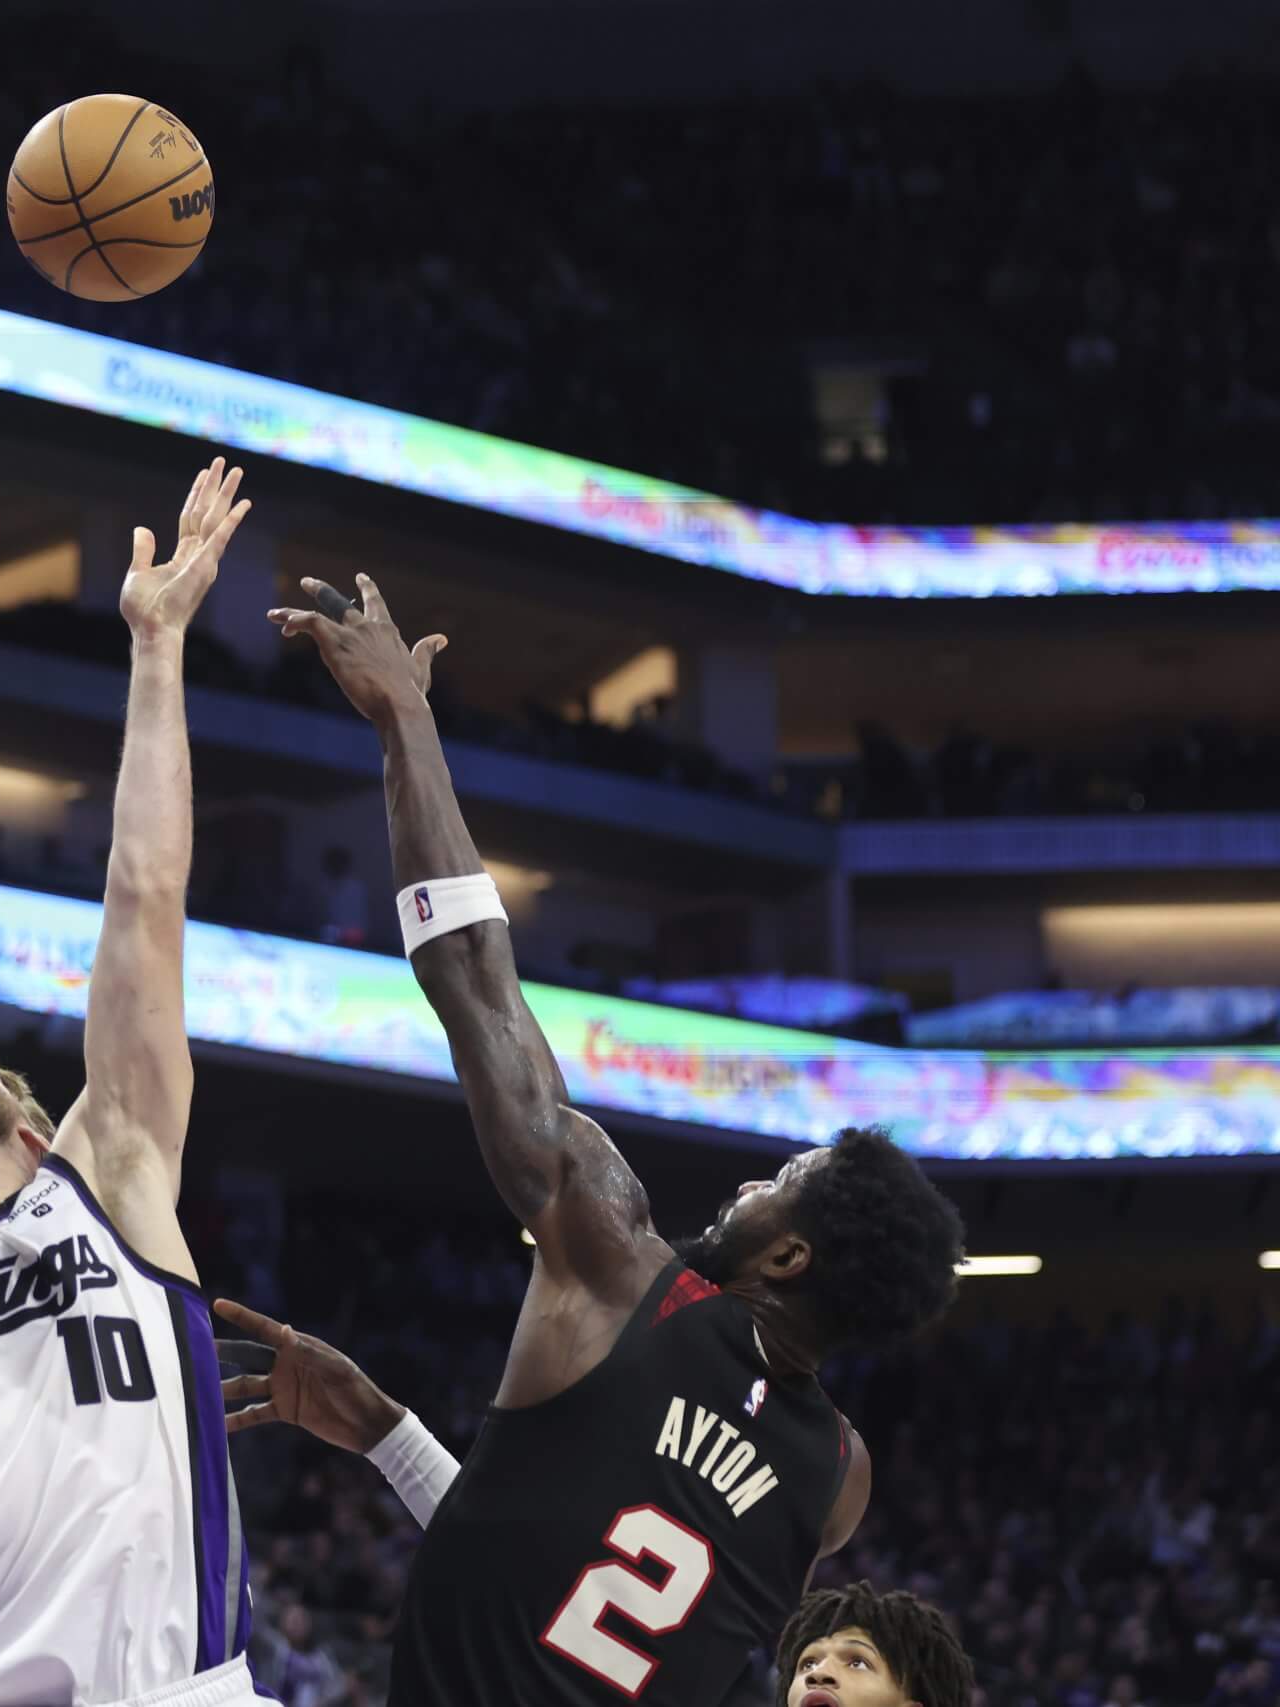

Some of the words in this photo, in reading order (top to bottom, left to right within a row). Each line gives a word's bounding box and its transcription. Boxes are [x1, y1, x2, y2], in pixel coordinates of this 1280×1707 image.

[56, 1315, 157, 1407] 10
[655, 1395, 779, 1519] AYTON
[537, 1502, 716, 1700] 2
